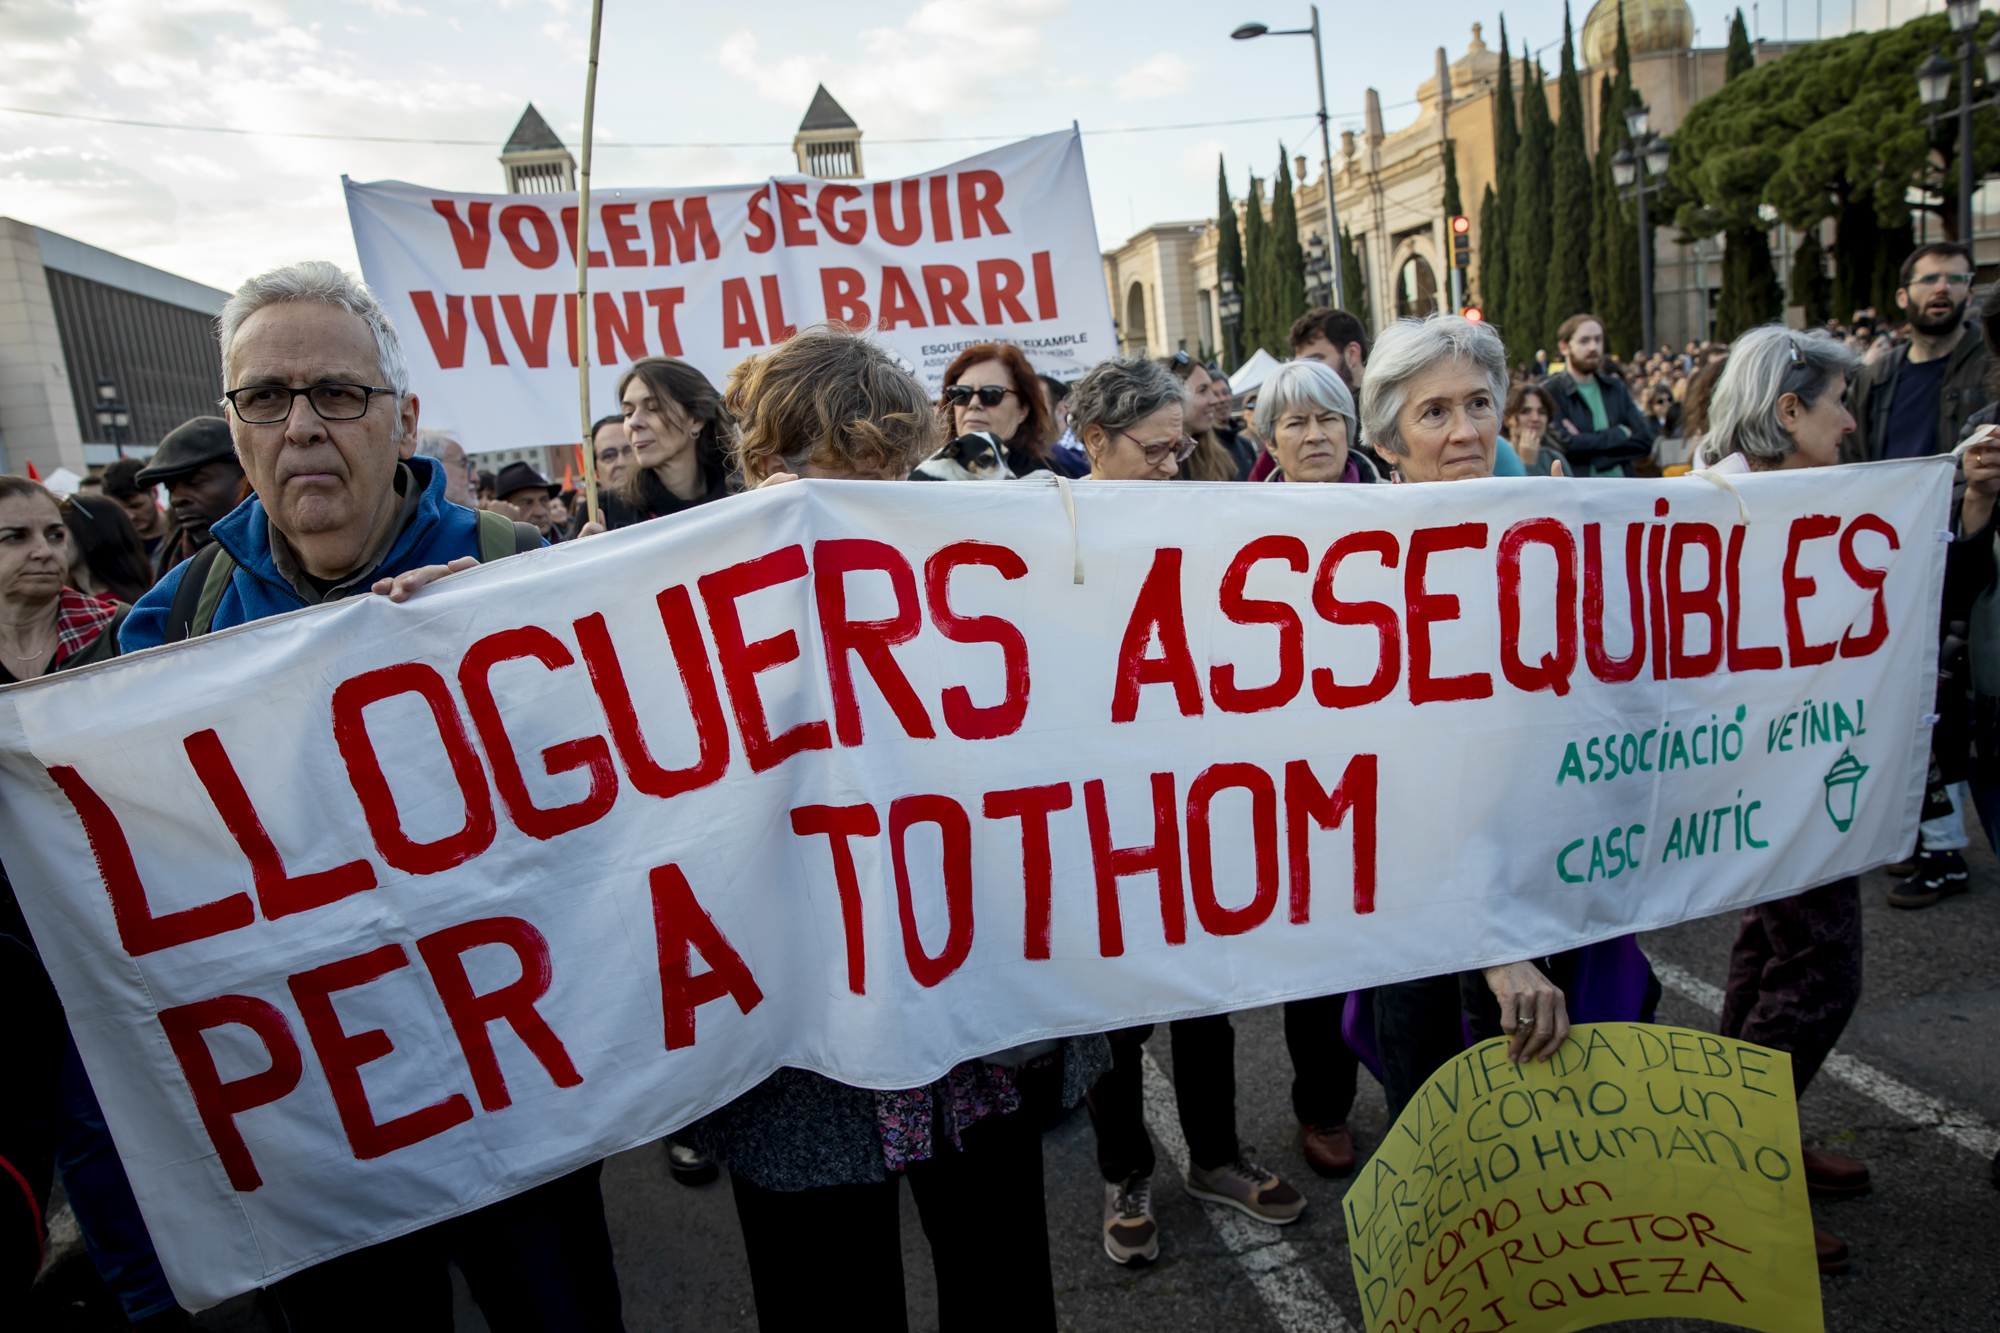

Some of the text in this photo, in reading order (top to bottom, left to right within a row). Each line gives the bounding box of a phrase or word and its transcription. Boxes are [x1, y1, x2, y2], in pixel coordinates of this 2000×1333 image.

[431, 169, 1011, 269] VOLEM SEGUIR
[409, 250, 1058, 369] VIVINT AL BARRI
[47, 538, 1031, 957] LLOGUERS
[1767, 698, 1868, 755] VEÏNAL
[1555, 822, 1646, 884] CASC
[157, 752, 1379, 1192] PER A TOTHOM
[1348, 1158, 1397, 1239] LA
[1627, 1025, 1778, 1097] DEBE
[1353, 1123, 1458, 1275] VERSE
[1363, 1142, 1521, 1325] DERECHO
